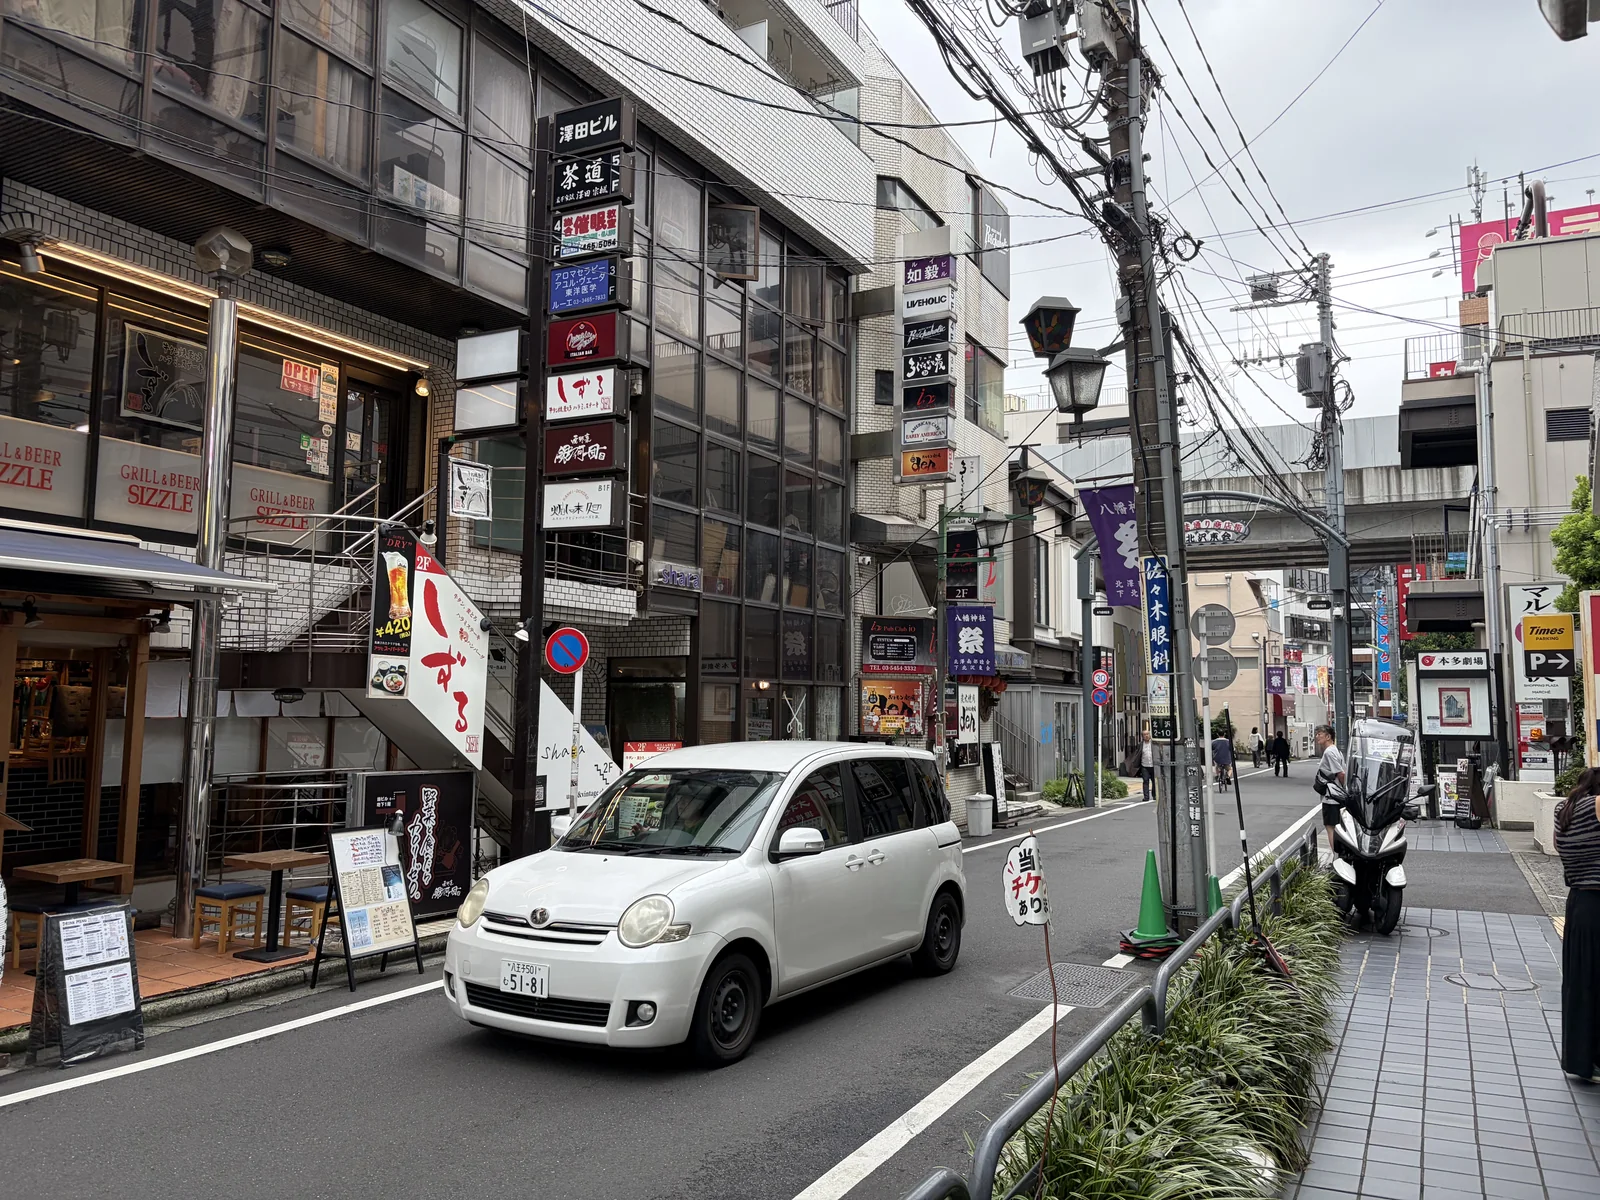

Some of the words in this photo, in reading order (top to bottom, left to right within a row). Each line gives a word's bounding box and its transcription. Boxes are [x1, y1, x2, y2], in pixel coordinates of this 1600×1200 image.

[559, 114, 618, 143] 澤田ビル
[561, 158, 604, 190] 茶道
[565, 284, 597, 297] 東洋医学
[906, 295, 947, 309] LIVEHOLIC
[284, 361, 318, 385] OPEN
[920, 430, 945, 438] AMERICAN
[25, 445, 61, 468] BEER
[120, 465, 160, 486] GRILL
[170, 473, 201, 492] BEER
[598, 484, 610, 492] B1F
[128, 485, 194, 514] SIZZLE
[250, 487, 282, 506] GRILL
[290, 494, 315, 512] BEER
[256, 506, 310, 531] SIZZLE
[417, 556, 431, 570] 2F
[662, 564, 700, 589] shara
[955, 588, 969, 598] 2F
[954, 614, 986, 622] 八幡神社
[1146, 561, 1170, 672] 佐々木眼科
[375, 616, 410, 638] ¥420
[1529, 626, 1565, 635] Times
[958, 626, 984, 654] 祭
[421, 578, 468, 733] しずる
[1439, 657, 1483, 665] 本多劇場
[1530, 653, 1546, 670] P
[1095, 673, 1106, 683] 30
[541, 743, 585, 760] shaa
[637, 743, 647, 751] 2F
[603, 762, 613, 773] 2F
[510, 962, 525, 973] 八王子
[526, 965, 537, 975] 501
[503, 977, 509, 986] む
[510, 974, 543, 995] 51-81
